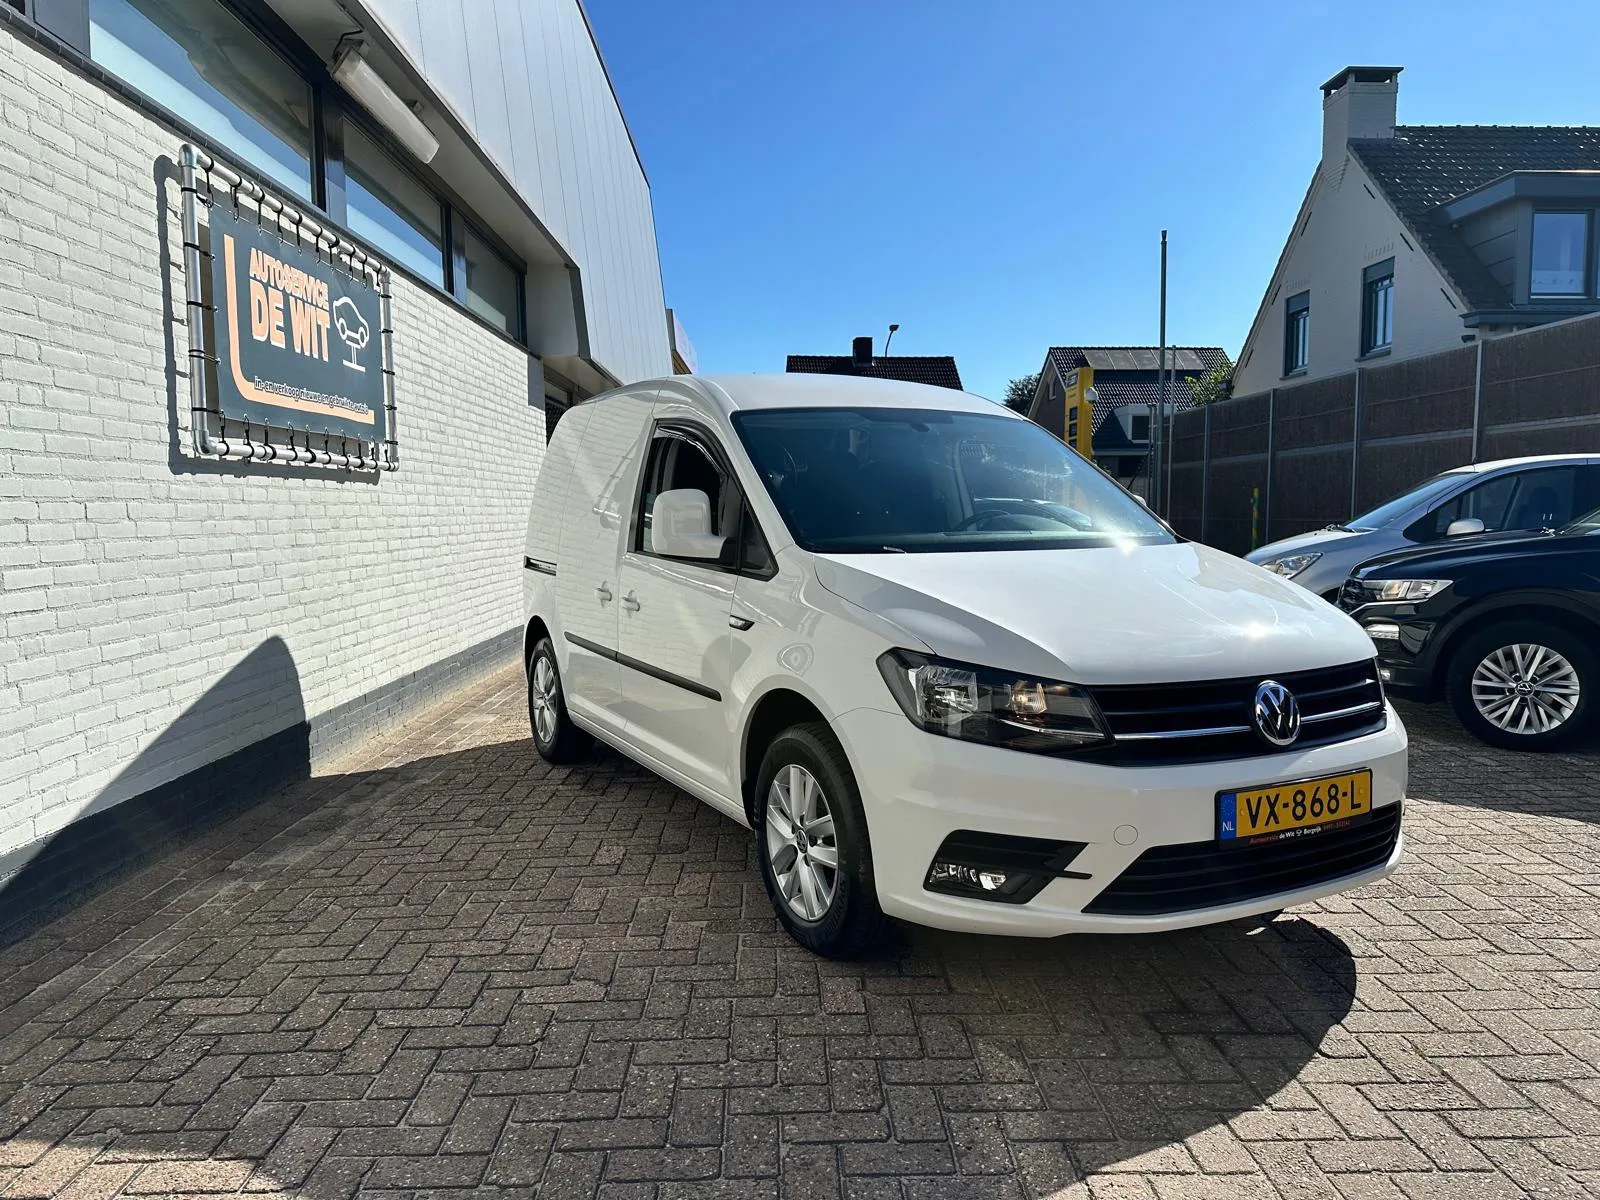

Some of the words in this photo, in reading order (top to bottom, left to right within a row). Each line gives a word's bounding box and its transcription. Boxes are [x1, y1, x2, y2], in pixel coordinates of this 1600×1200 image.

[250, 247, 329, 311] AUTOSERVICE
[250, 279, 286, 349] DE
[289, 296, 330, 362] WIT
[265, 381, 274, 393] en
[274, 383, 300, 401] verkoop
[300, 388, 321, 403] nieuwe
[1222, 821, 1235, 832] NL
[1245, 780, 1362, 829] VX-868-L
